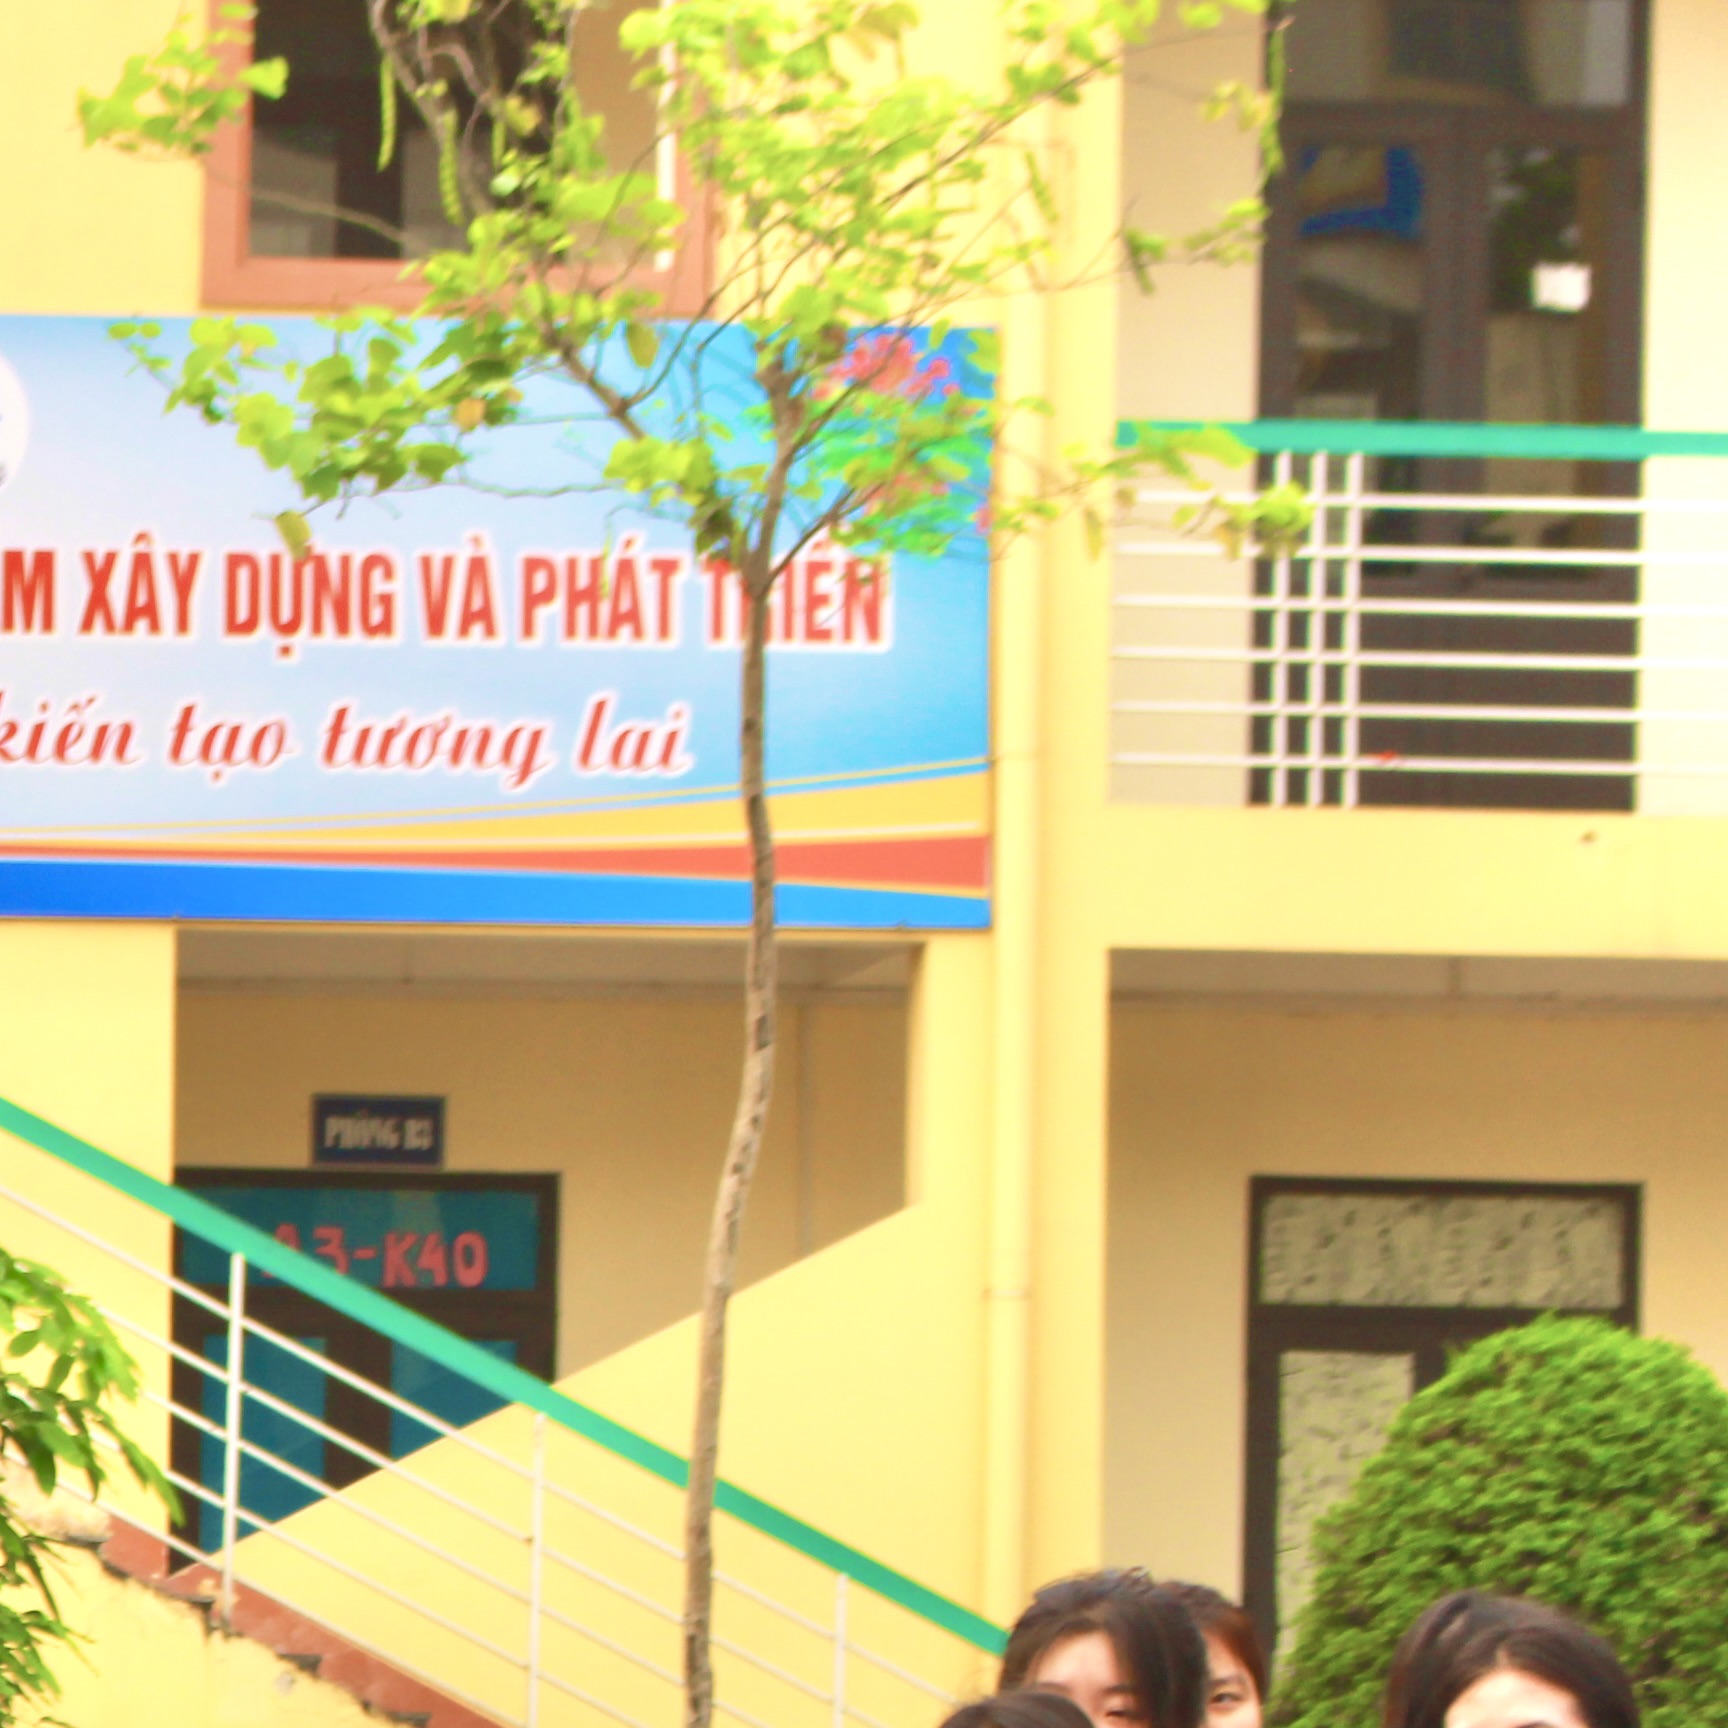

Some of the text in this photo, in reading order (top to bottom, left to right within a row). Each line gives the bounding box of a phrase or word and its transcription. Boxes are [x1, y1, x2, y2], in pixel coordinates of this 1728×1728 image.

[77, 530, 202, 636] XÂY
[222, 542, 396, 658] DỰNG
[417, 534, 499, 640] VÀ
[519, 534, 682, 643] PHÁT
[167, 703, 289, 784] tạo
[321, 704, 549, 789] tương
[575, 693, 688, 771] lai
